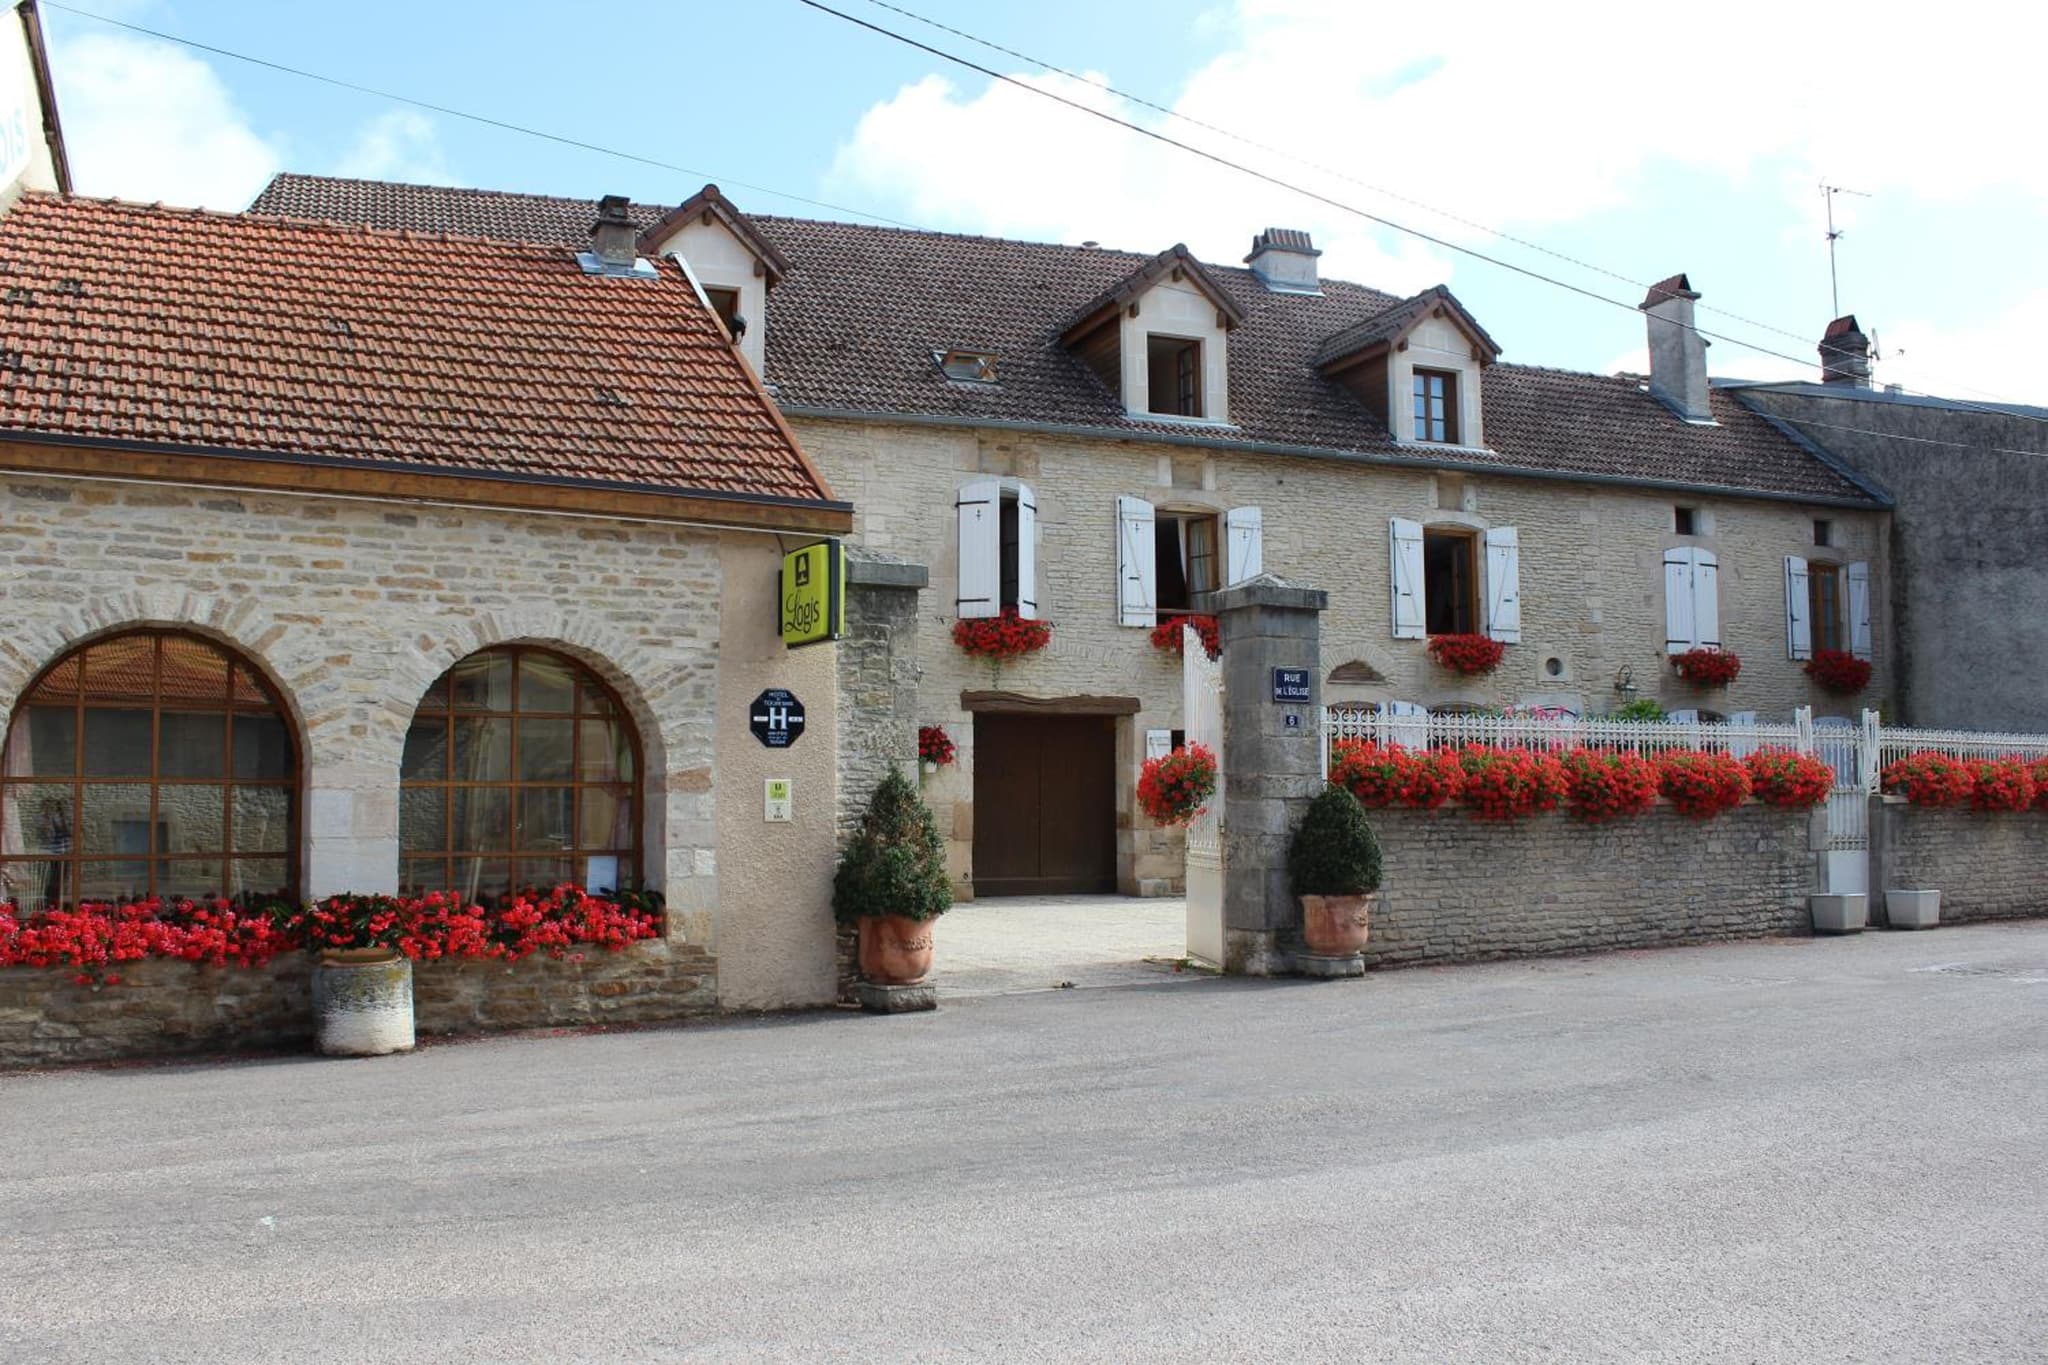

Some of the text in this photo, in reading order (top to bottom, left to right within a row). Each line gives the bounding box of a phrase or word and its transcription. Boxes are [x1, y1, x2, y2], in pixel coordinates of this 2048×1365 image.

[784, 589, 820, 634] Logis
[1284, 673, 1301, 682] RUE
[769, 707, 788, 730] H
